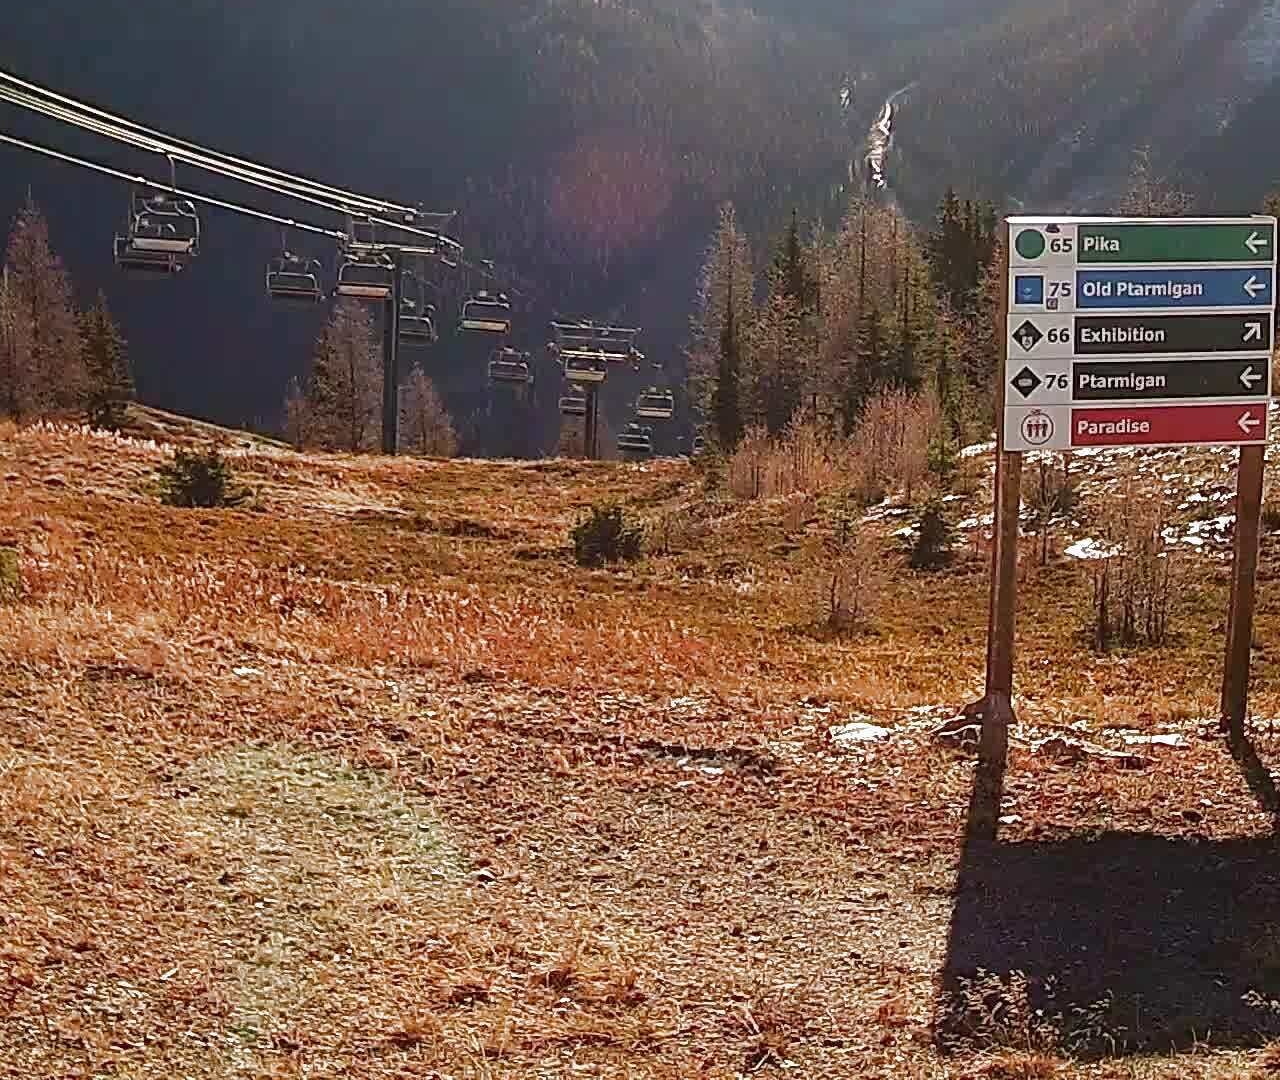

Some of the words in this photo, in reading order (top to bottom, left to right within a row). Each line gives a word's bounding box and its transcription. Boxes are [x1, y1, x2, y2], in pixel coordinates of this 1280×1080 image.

[1050, 238, 1073, 253] 65
[1083, 236, 1120, 252] Pika
[1048, 282, 1071, 297] 75
[1082, 281, 1111, 297] Old
[1116, 280, 1203, 299] Ptarmigan
[1047, 328, 1070, 343] 66
[1080, 326, 1165, 343] Exhibition
[1045, 374, 1068, 390] 76
[1079, 372, 1166, 390] Ptarmigan
[1077, 419, 1150, 435] Paradise
